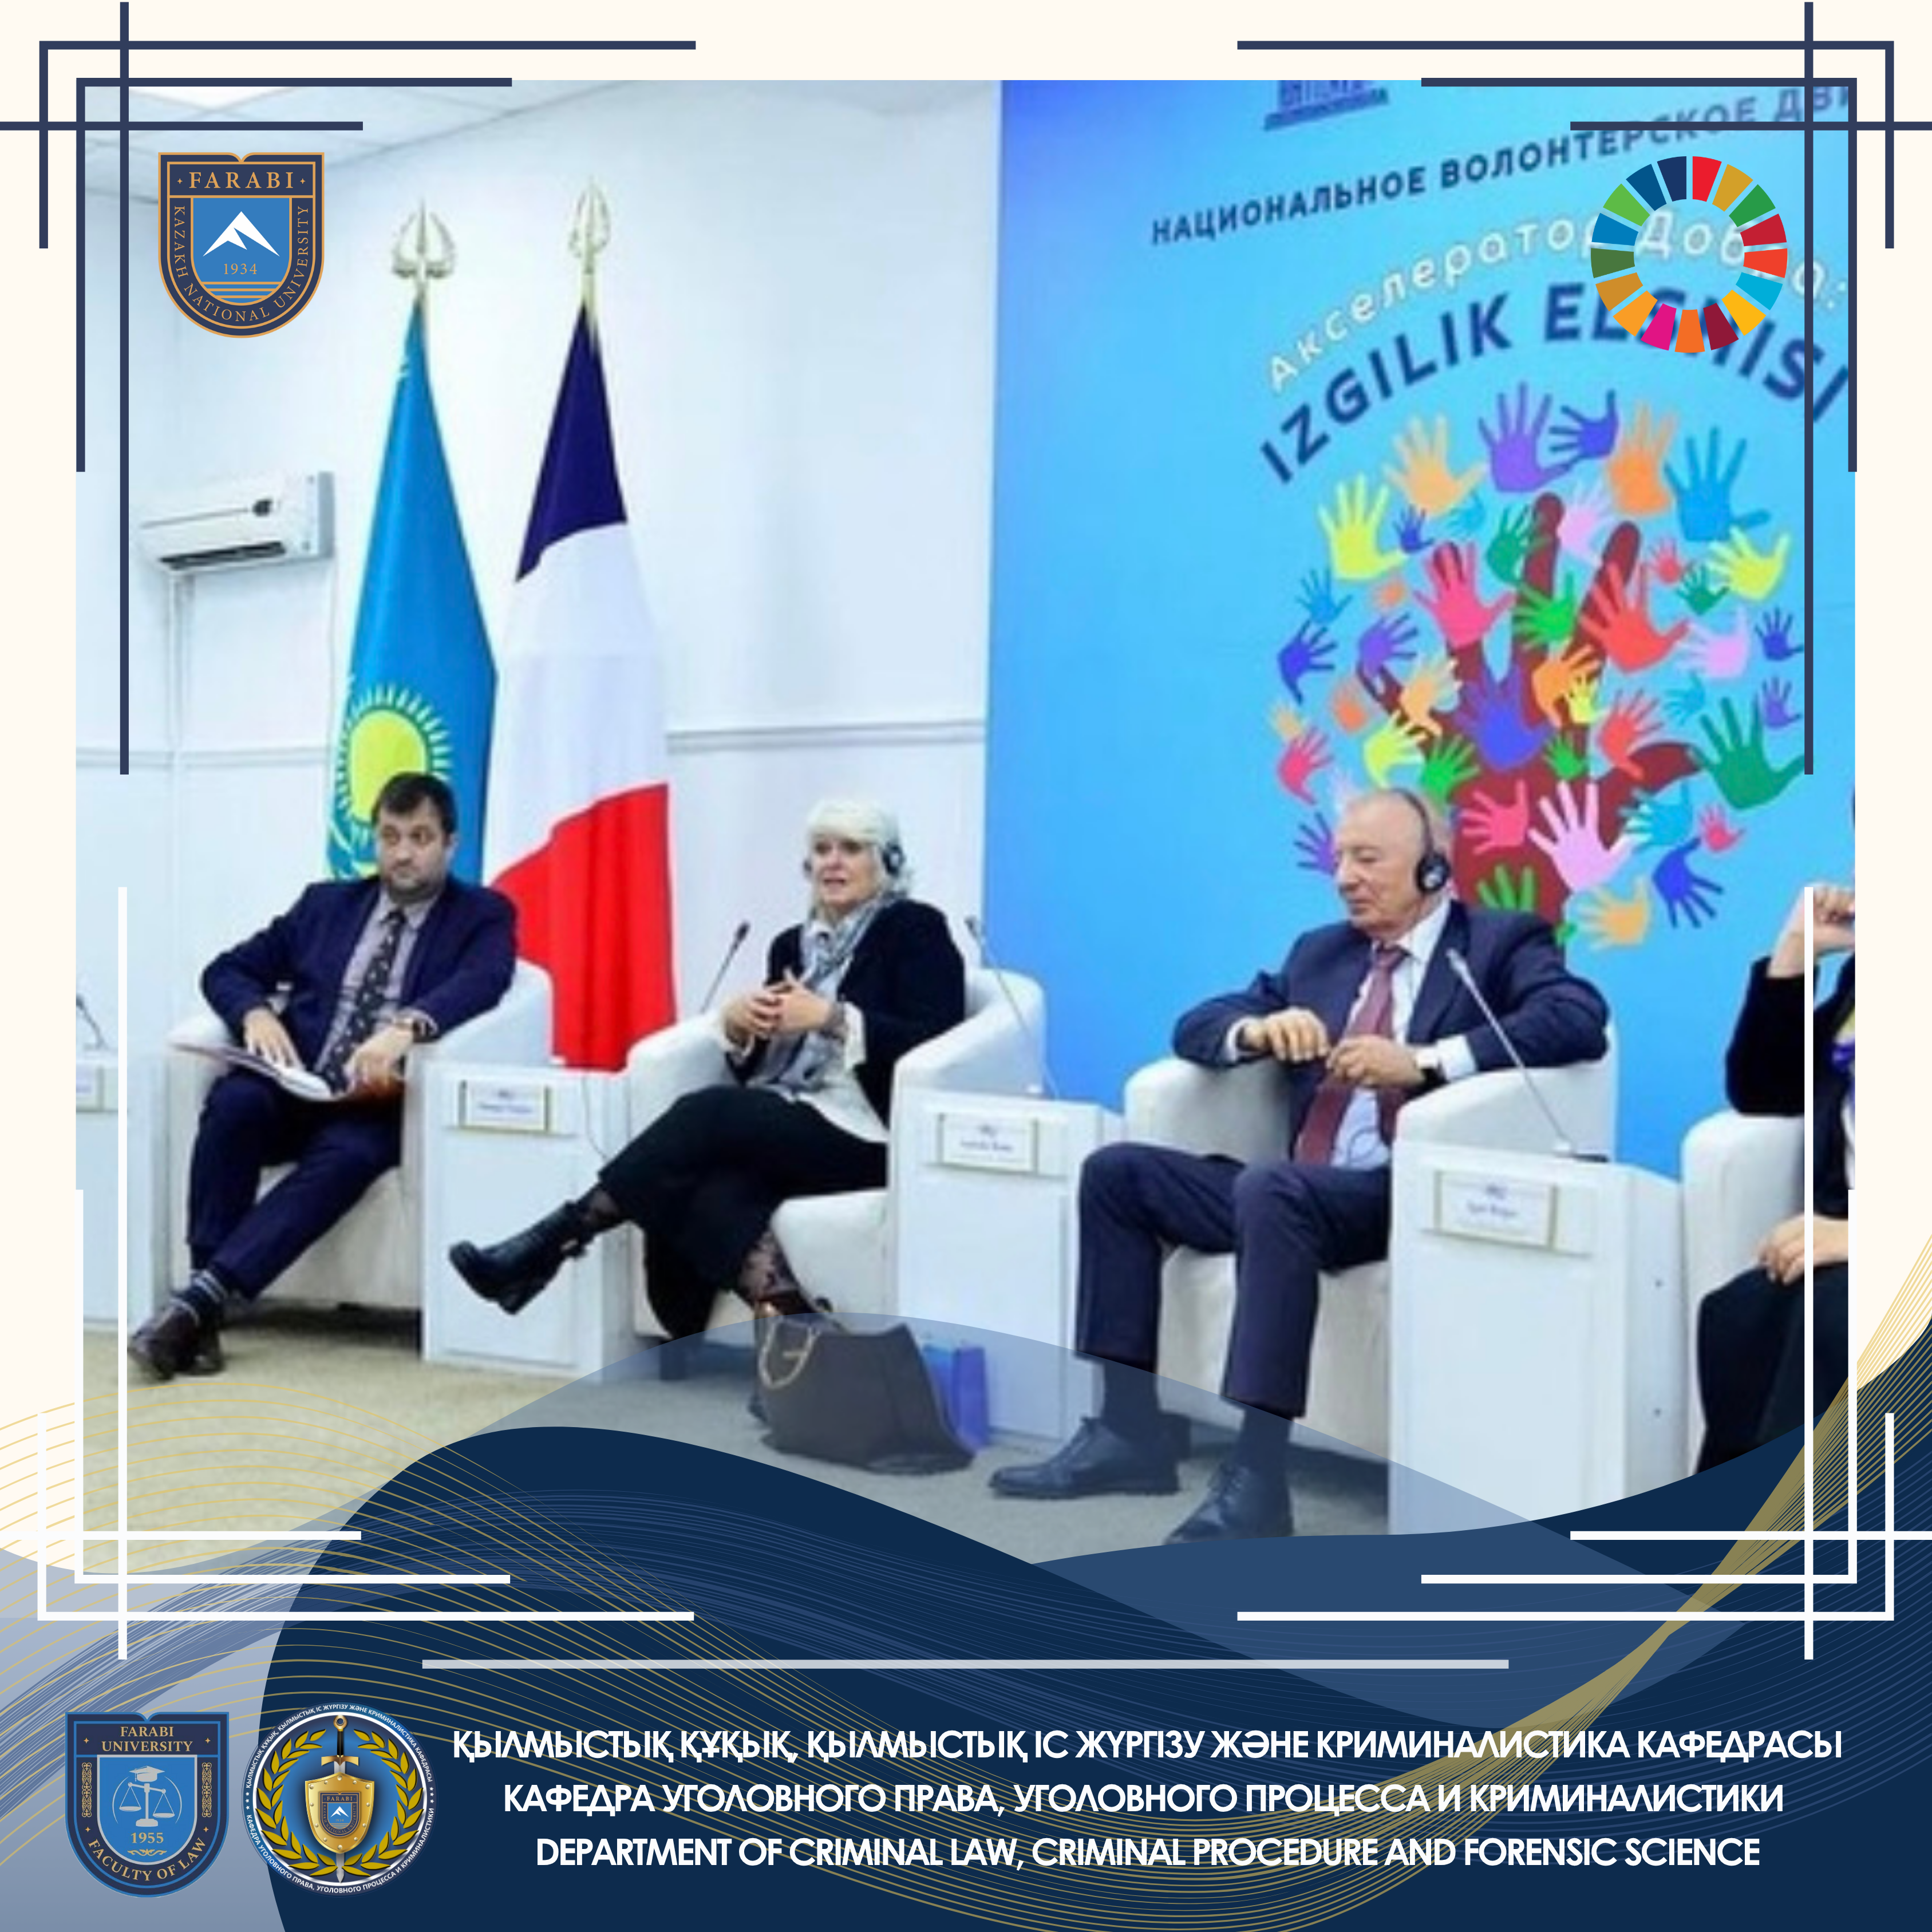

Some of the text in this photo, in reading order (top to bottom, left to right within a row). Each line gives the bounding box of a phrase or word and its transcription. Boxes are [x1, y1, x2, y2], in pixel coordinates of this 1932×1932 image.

[1152, 167, 1427, 245] НАЦИОНАЛЬНОЕ
[1440, 97, 1757, 188] ВОЛОНТЕРСКОЕ
[1634, 209, 1848, 310] Доба:
[1261, 291, 1512, 485] IZGILIK
